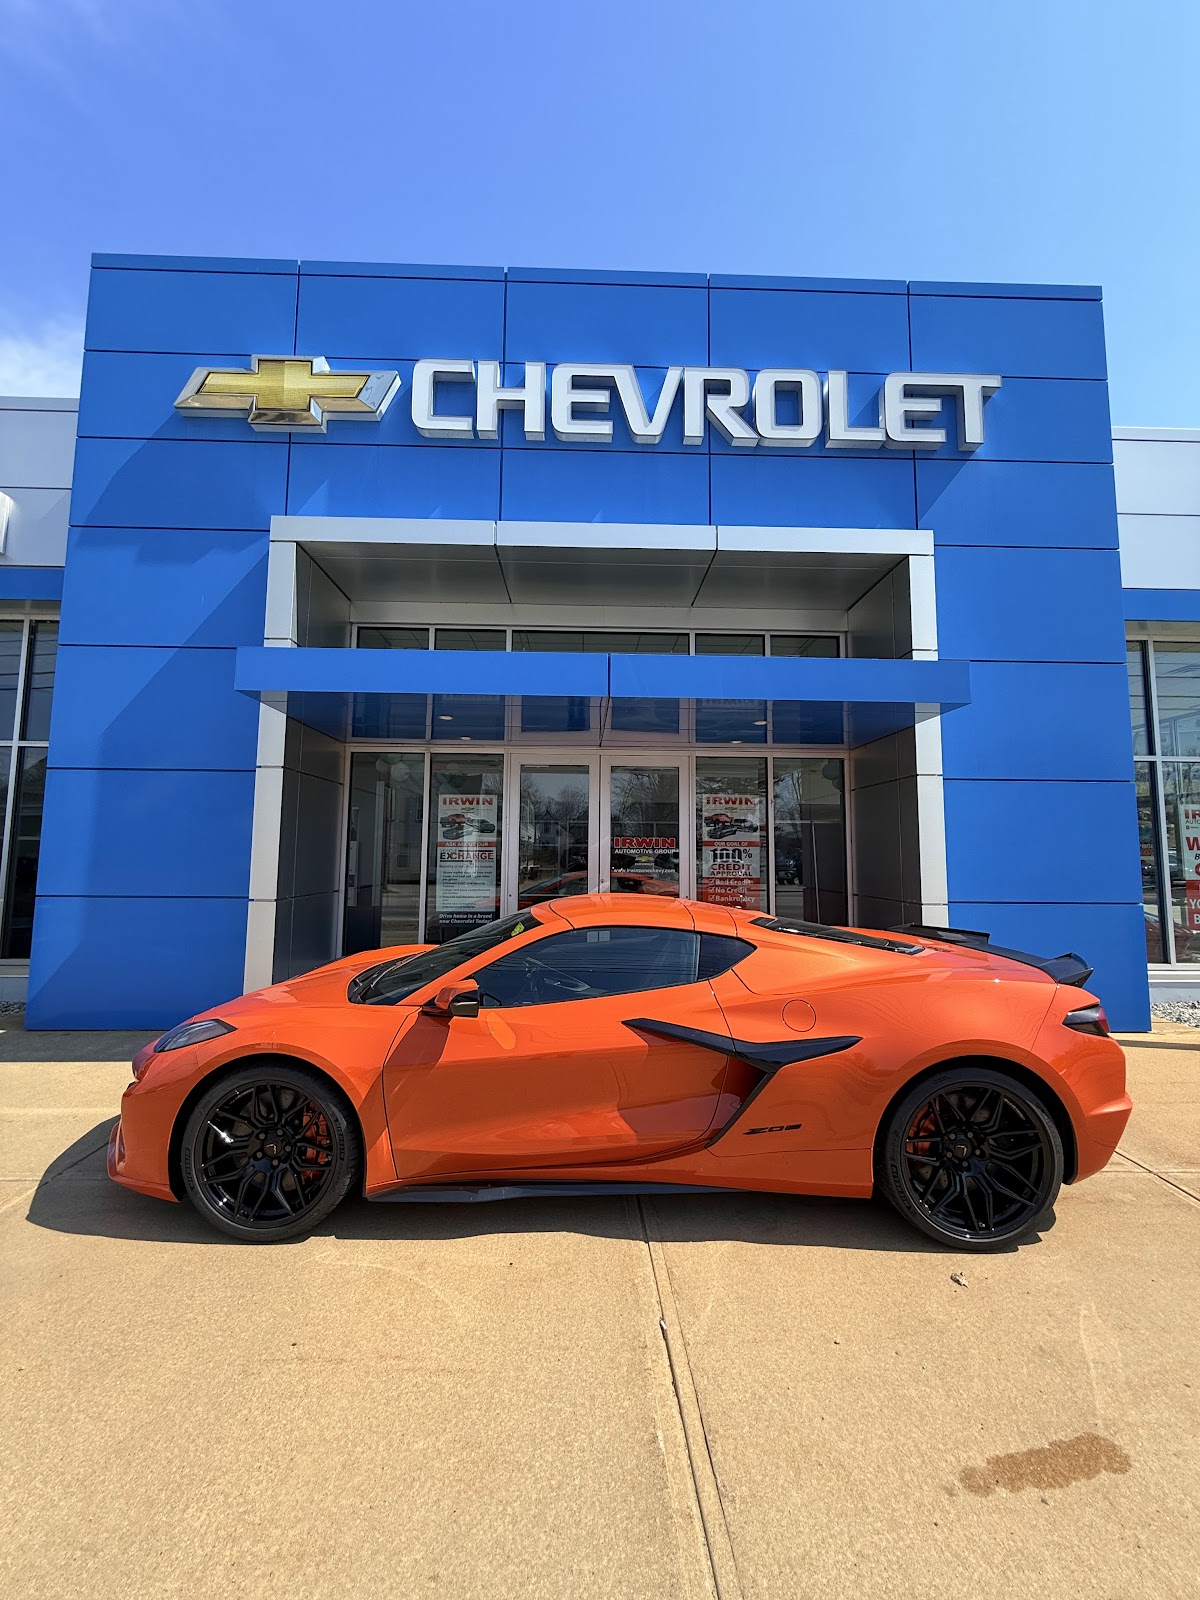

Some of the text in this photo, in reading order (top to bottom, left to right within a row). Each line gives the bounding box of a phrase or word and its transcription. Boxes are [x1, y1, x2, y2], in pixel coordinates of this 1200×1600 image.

[411, 358, 1002, 452] CHEVROLET
[443, 797, 493, 805] IRWIN
[706, 797, 757, 805] IRWIN
[614, 837, 676, 848] IRWIN
